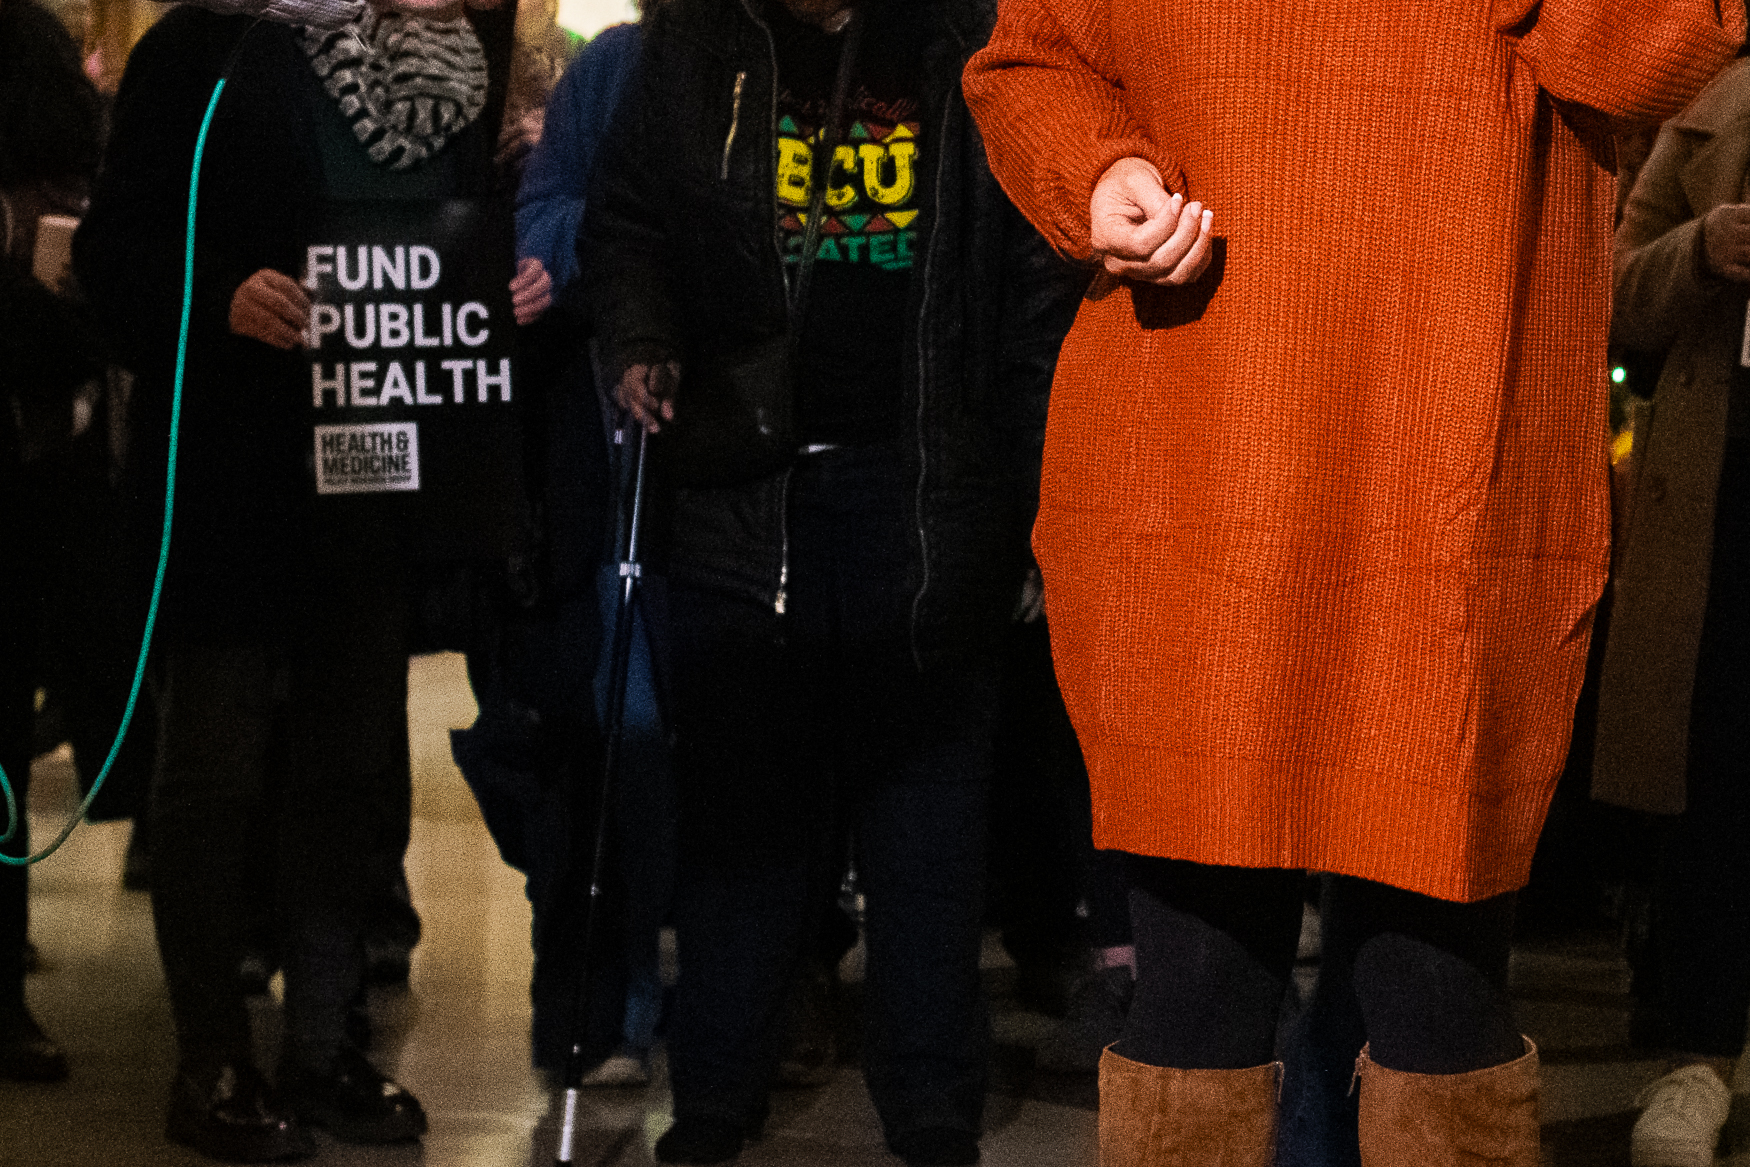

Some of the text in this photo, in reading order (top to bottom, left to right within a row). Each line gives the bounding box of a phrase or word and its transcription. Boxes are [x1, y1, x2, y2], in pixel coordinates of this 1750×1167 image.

[306, 245, 441, 291] FUND
[310, 301, 489, 349] PUBLIC
[312, 358, 512, 407] HEALTH
[322, 432, 392, 453] HEALTH
[323, 453, 411, 475] MEDICINE
